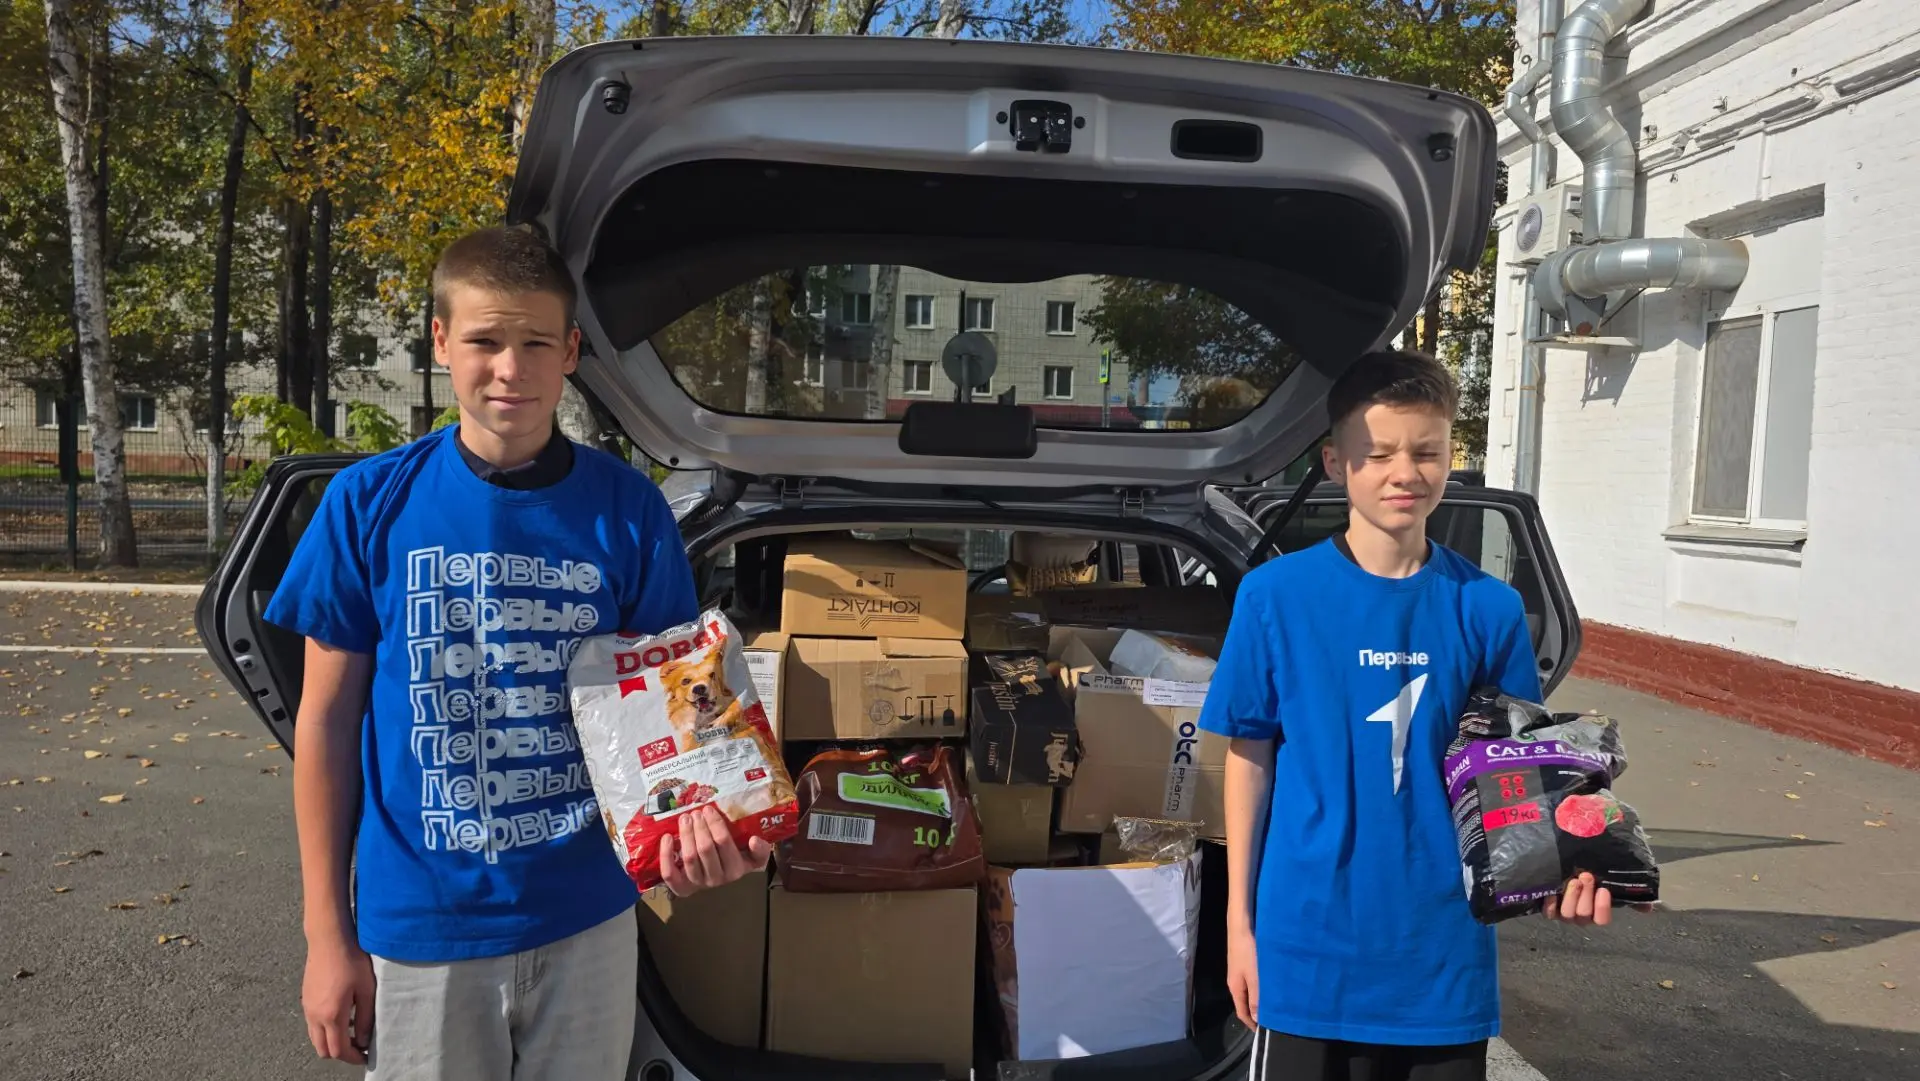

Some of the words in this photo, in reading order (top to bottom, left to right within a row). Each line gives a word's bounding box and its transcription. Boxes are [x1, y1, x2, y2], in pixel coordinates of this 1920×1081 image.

[407, 545, 601, 598] Первые
[407, 590, 599, 644] Первые
[827, 598, 921, 615] КОНТАКТ
[1359, 649, 1429, 670] Первые
[1533, 745, 1549, 754] &
[760, 817, 770, 830] 2
[770, 813, 786, 825] кг
[913, 826, 939, 849] 10
